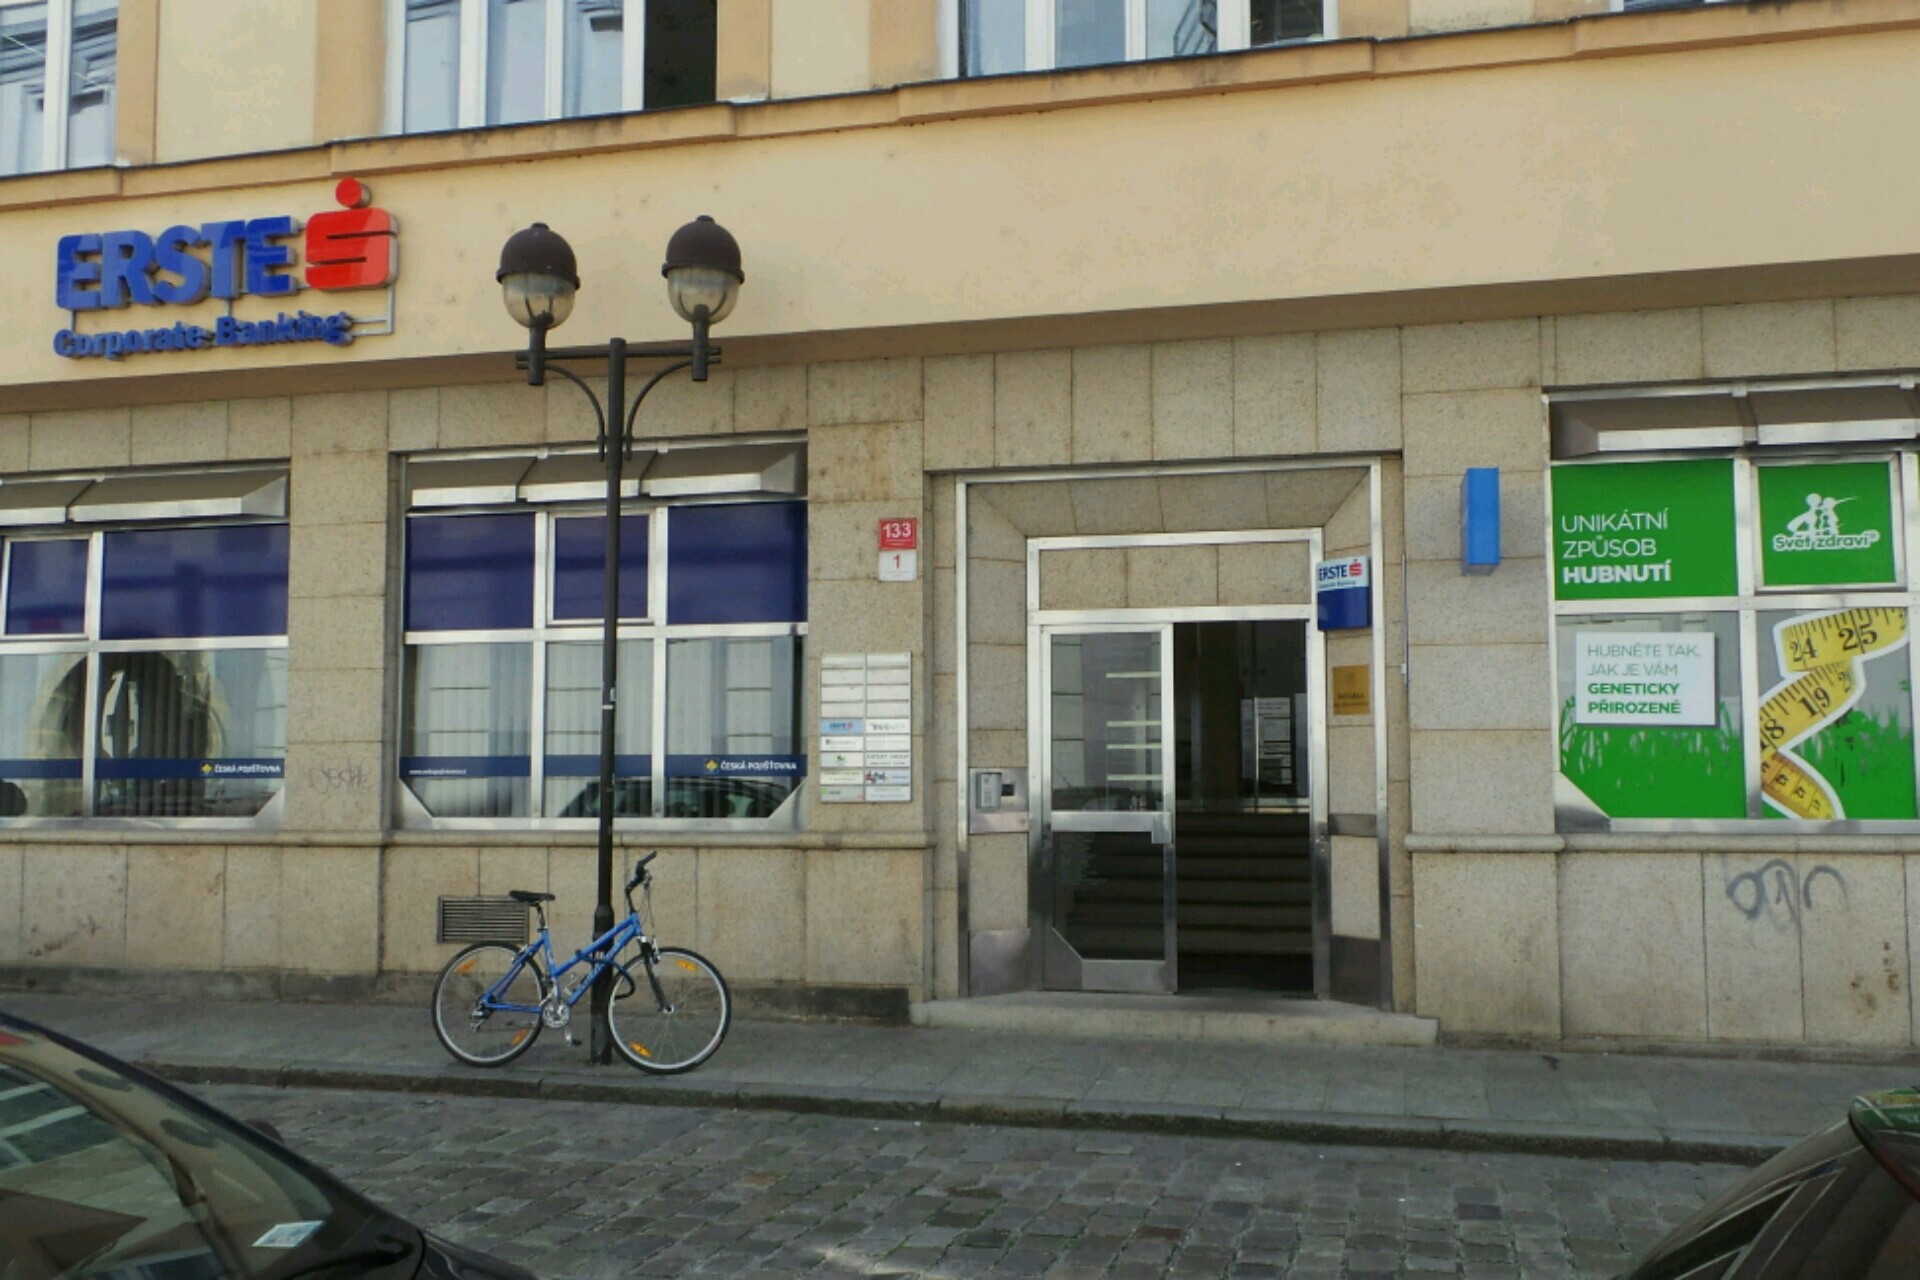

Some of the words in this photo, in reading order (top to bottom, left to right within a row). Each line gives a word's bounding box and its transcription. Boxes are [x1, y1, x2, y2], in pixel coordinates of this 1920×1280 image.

[56, 216, 296, 309] ERSTE
[54, 322, 203, 359] Corporate
[216, 310, 346, 346] Banking
[883, 522, 912, 538] 133
[1561, 507, 1669, 533] UNIKÁTNÍ
[1562, 536, 1657, 559] ZPŮSOB
[892, 554, 900, 569] 1
[1318, 564, 1348, 581] ERSTE
[1563, 559, 1672, 584] HUBNUTÍ
[1838, 621, 1878, 651] 25
[1587, 641, 1662, 657] HUBNĚTE
[1789, 636, 1818, 662] 24
[1587, 663, 1619, 676] JAK
[1622, 663, 1639, 676] JE
[1643, 661, 1679, 676] VÁM
[1587, 683, 1680, 695] GENETICKY
[1587, 699, 1682, 714] PŘIROZENÉ
[1799, 686, 1832, 718] 19
